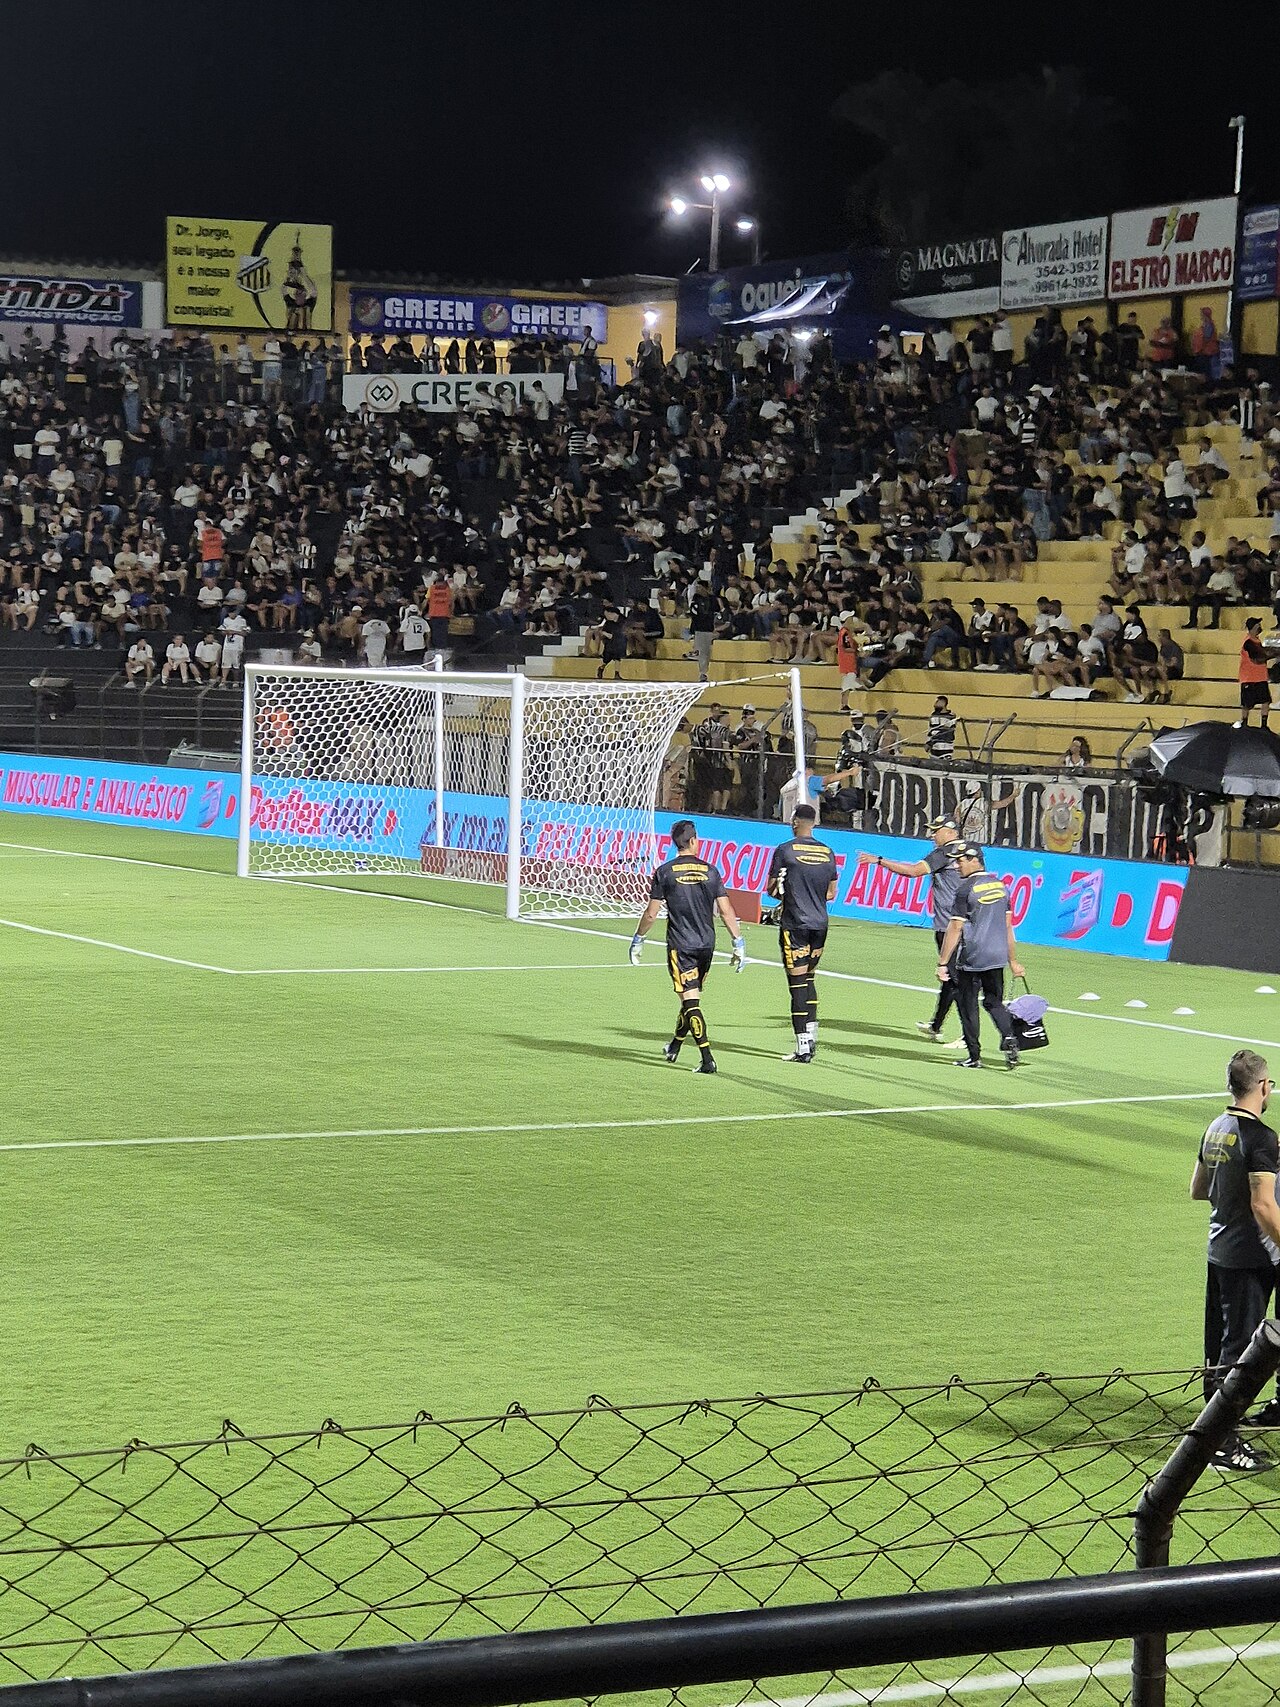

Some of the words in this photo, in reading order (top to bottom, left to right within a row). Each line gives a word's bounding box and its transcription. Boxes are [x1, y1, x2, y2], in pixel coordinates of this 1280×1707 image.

[175, 224, 193, 236] Dr.
[196, 226, 232, 241] Jorge,
[1073, 227, 1103, 259] Hotel
[173, 246, 193, 256] seu
[195, 246, 236, 260] legado
[918, 238, 999, 271] MAGNATA
[188, 267, 194, 276] a
[197, 267, 231, 278] nossa
[1111, 254, 1171, 293] ELETRO
[1174, 246, 1232, 286] MARCO
[187, 285, 221, 296] maior
[4, 309, 125, 323] CONSTRUÇÃO
[384, 297, 475, 322] GREEN
[511, 303, 599, 328] GREEN
[3, 769, 80, 810] MUSCULAR
[80, 777, 95, 812] E
